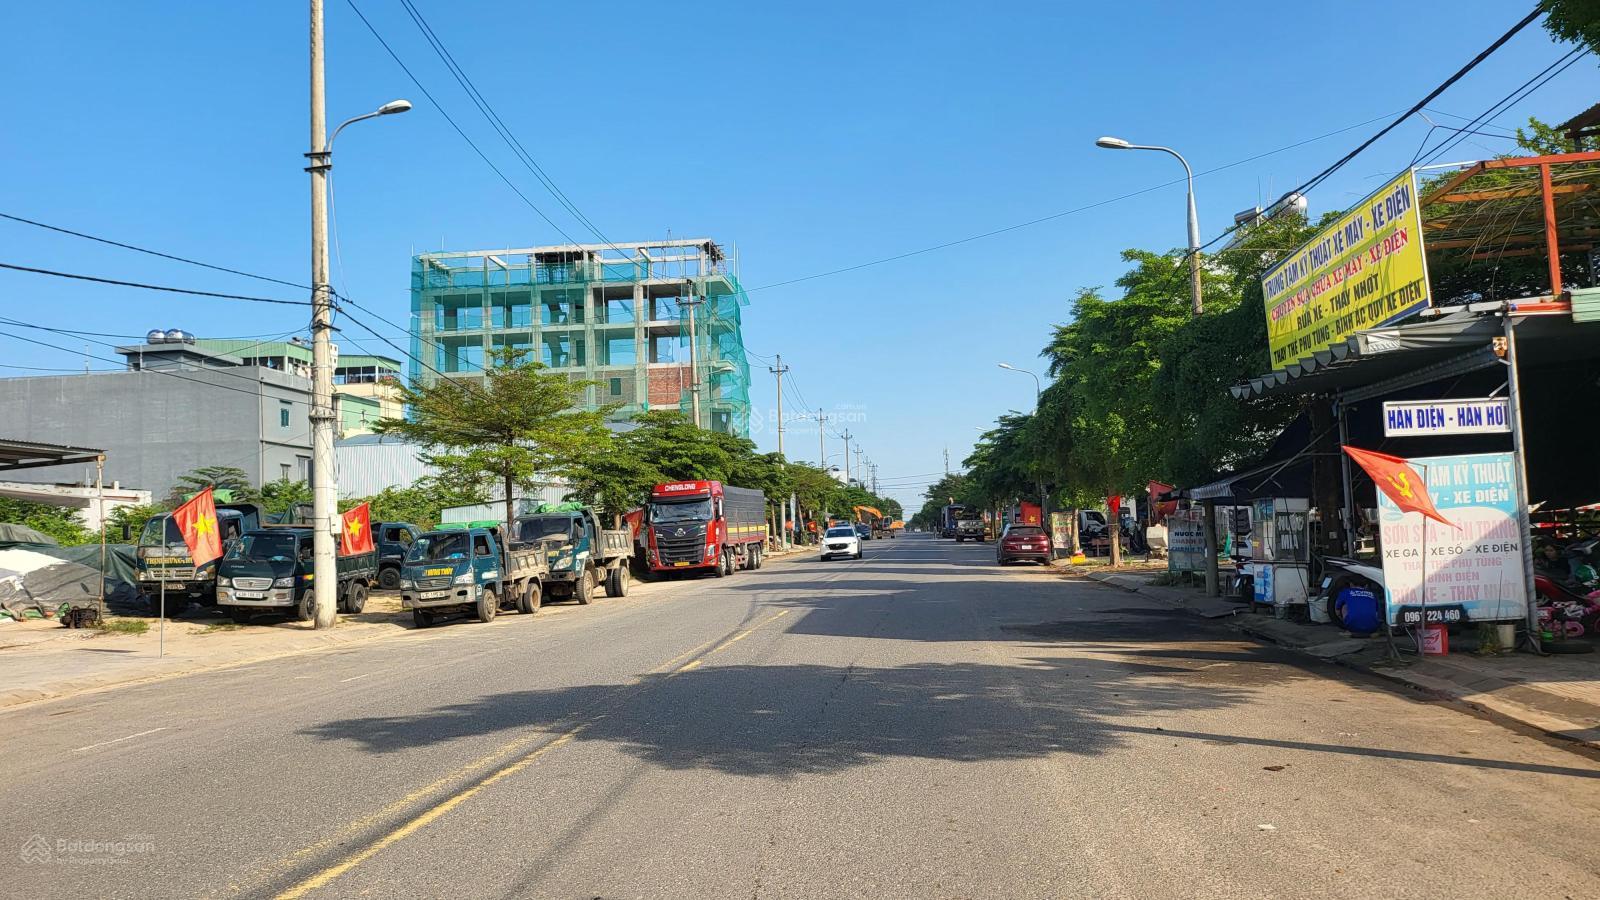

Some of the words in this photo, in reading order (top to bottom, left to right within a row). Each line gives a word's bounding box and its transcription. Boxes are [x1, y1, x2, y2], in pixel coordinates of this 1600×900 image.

[1265, 271, 1285, 300] TRUNG
[1284, 262, 1299, 288] TÂM
[1309, 238, 1332, 271] THUẬT
[1333, 230, 1344, 256] XE
[1345, 214, 1364, 248] MÁY
[1371, 202, 1385, 232] XE
[1385, 185, 1411, 220] ĐIỆN
[1271, 295, 1296, 321] CHUYÊN
[1311, 272, 1331, 298] CHỮA
[1332, 266, 1344, 285] XE
[1344, 252, 1363, 277] MÁY
[1368, 244, 1382, 265] XE
[1384, 228, 1408, 257] ĐIỆN
[1313, 304, 1324, 323] XE
[1330, 287, 1350, 313] THAY
[1353, 273, 1379, 302] NHỚT
[1274, 345, 1287, 365] THAY
[1368, 296, 1384, 321] QUY
[1386, 292, 1398, 312] XE
[1398, 280, 1422, 307] ĐIỆN
[1387, 405, 1413, 430] HÀN
[1416, 404, 1445, 431] ĐIỆN
[1457, 402, 1482, 427] HÀN
[1472, 458, 1512, 487] THUẬT
[665, 484, 696, 492] CHENGLONG
[1454, 490, 1472, 504] XE
[1475, 486, 1509, 505] ĐIỆN
[1450, 518, 1473, 542] TÂN
[1476, 517, 1518, 540] TRANG
[1385, 549, 1400, 558] XE
[1403, 548, 1419, 557] GA
[1431, 547, 1445, 556] XE
[1447, 542, 1464, 555] SỐ
[1475, 544, 1490, 554] XE
[1492, 541, 1518, 555] ĐIỆN
[1403, 561, 1423, 571] THA
[1475, 555, 1502, 568] TÙNG
[1428, 570, 1452, 583] BÌNH
[1455, 570, 1480, 583] ĐIỆN
[1424, 587, 1437, 603] XE
[1450, 585, 1480, 601] THAY
[1427, 610, 1442, 621] 224
[1445, 609, 1460, 620] 460
